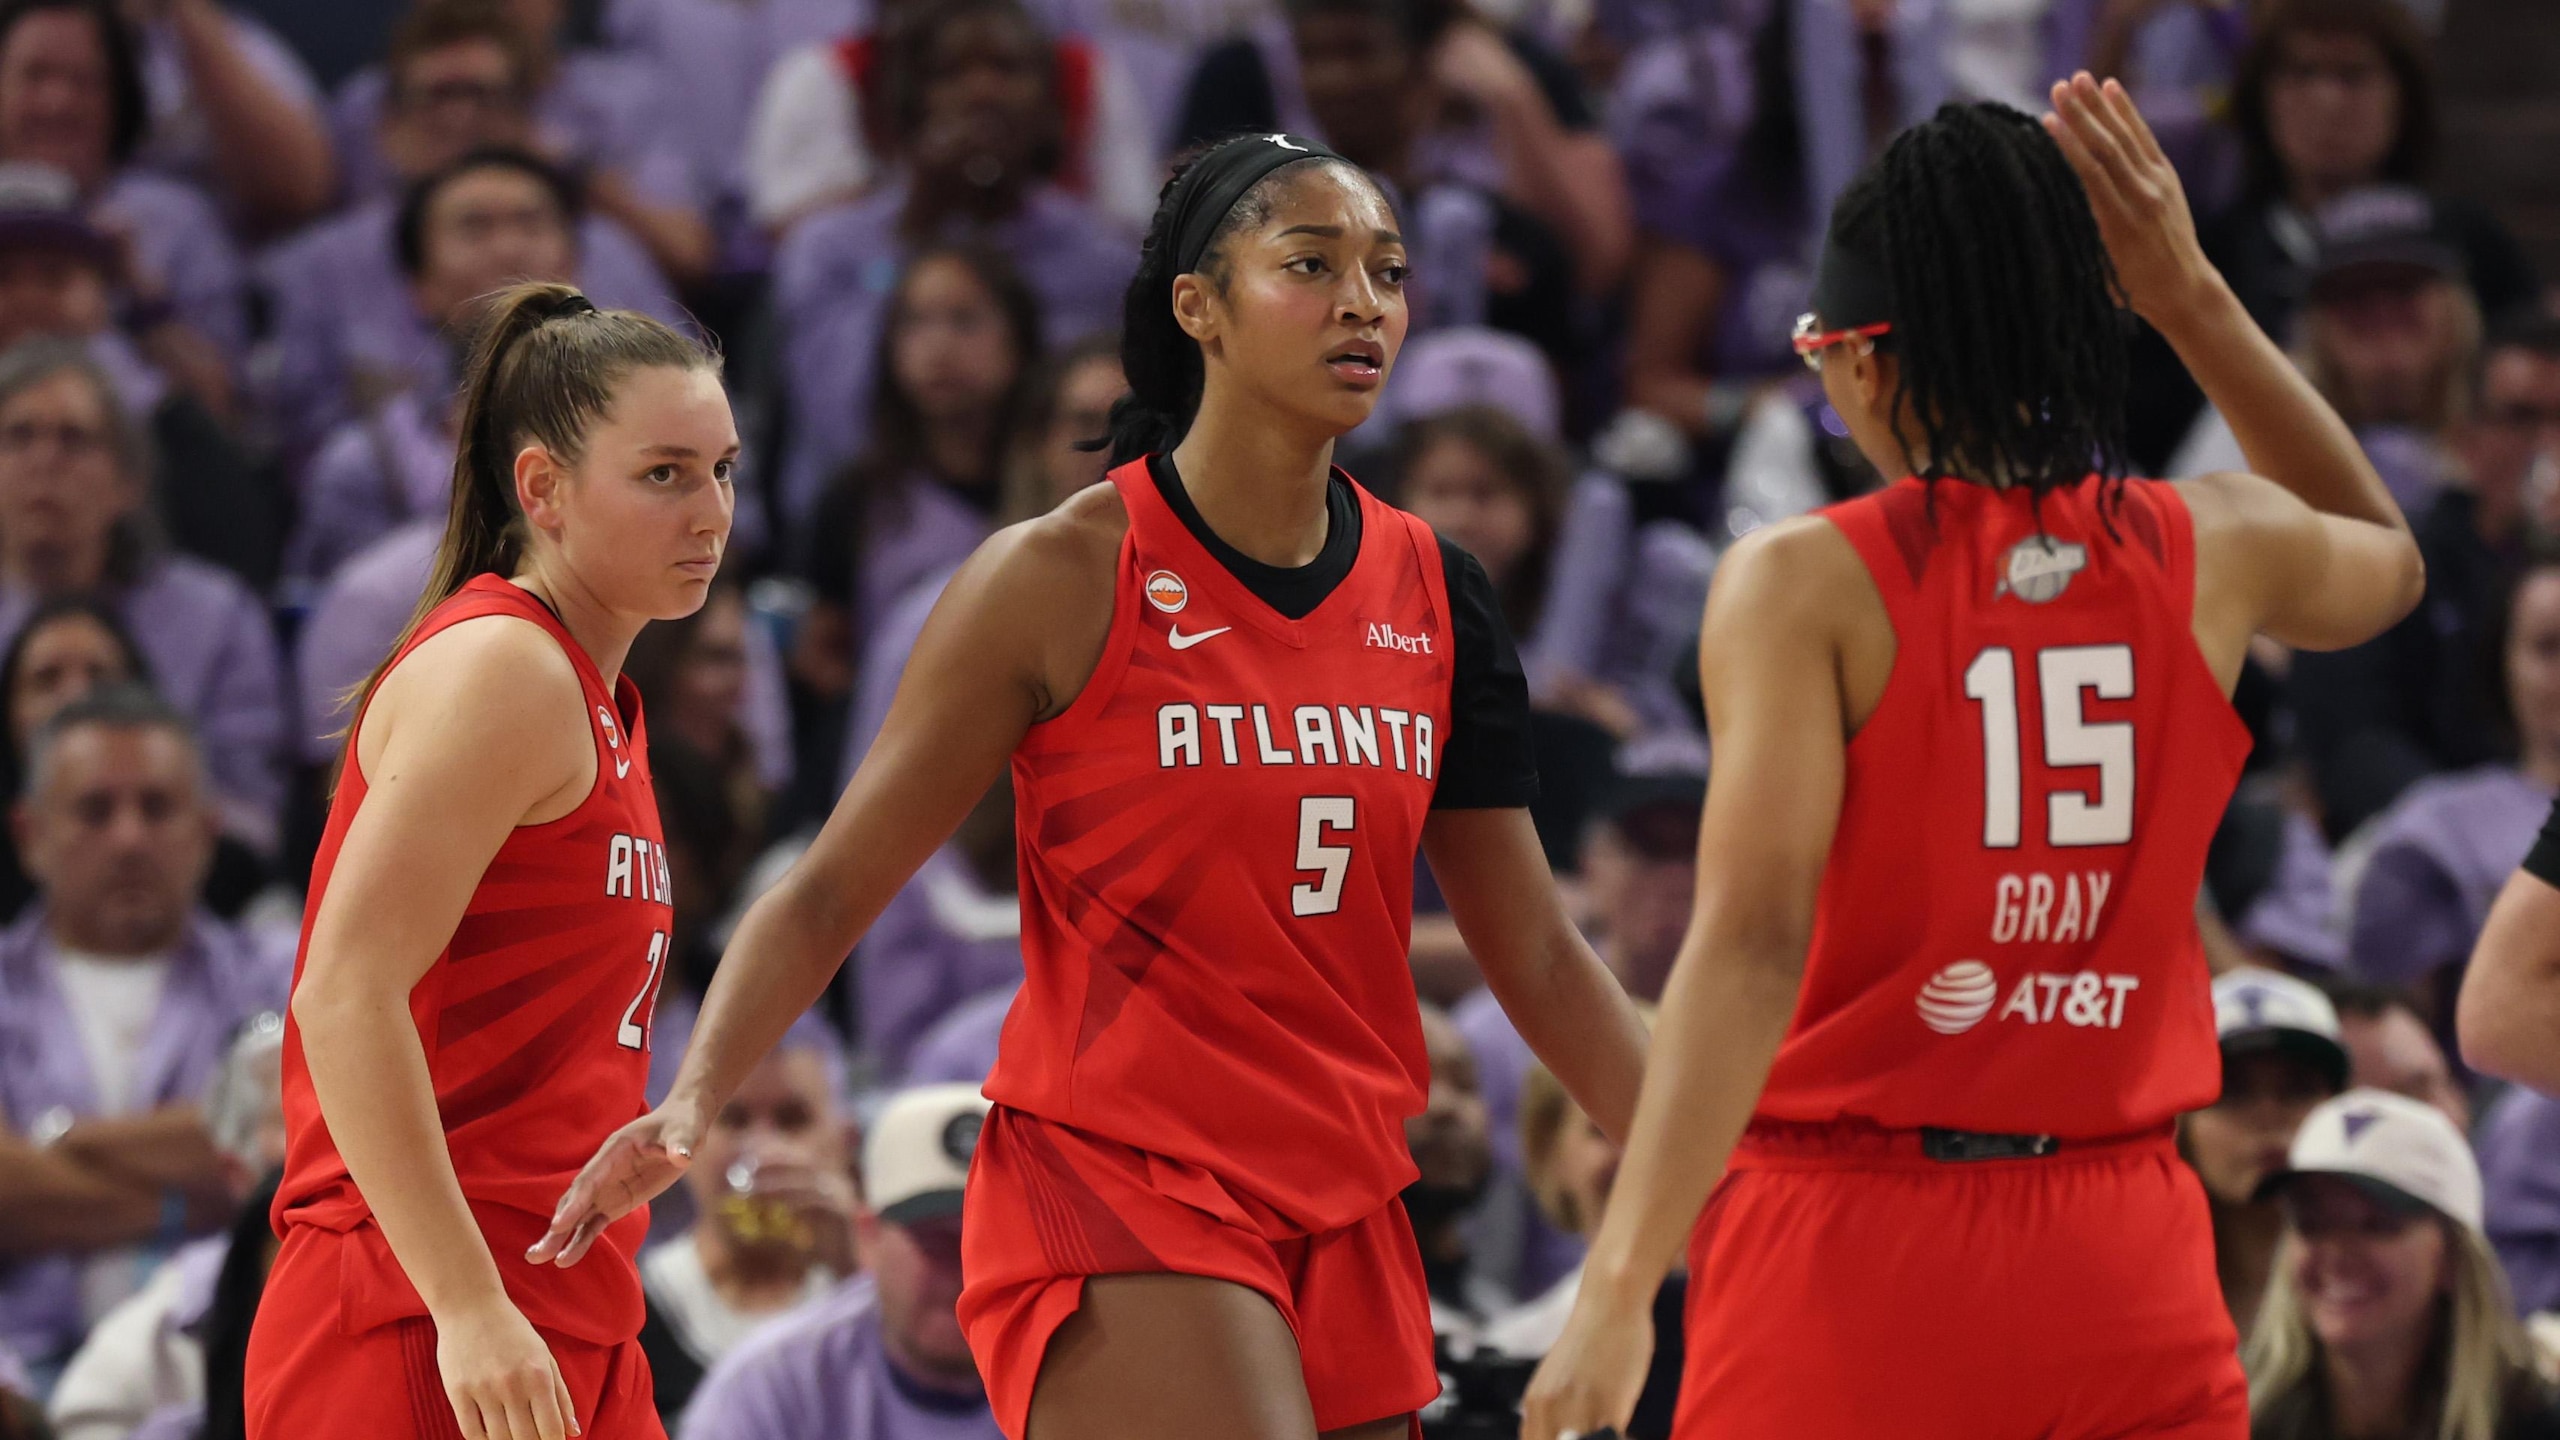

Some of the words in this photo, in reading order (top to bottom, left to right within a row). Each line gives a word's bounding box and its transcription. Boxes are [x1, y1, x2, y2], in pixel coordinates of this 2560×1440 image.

[1366, 622, 1434, 654] Albert
[1156, 702, 1434, 781] ATLANTA
[1964, 643, 2135, 849] 15
[1292, 796, 1356, 917] 5
[1991, 870, 2111, 944] GRAY
[617, 929, 672, 1052] 2
[2000, 970, 2140, 1029] AT&T
